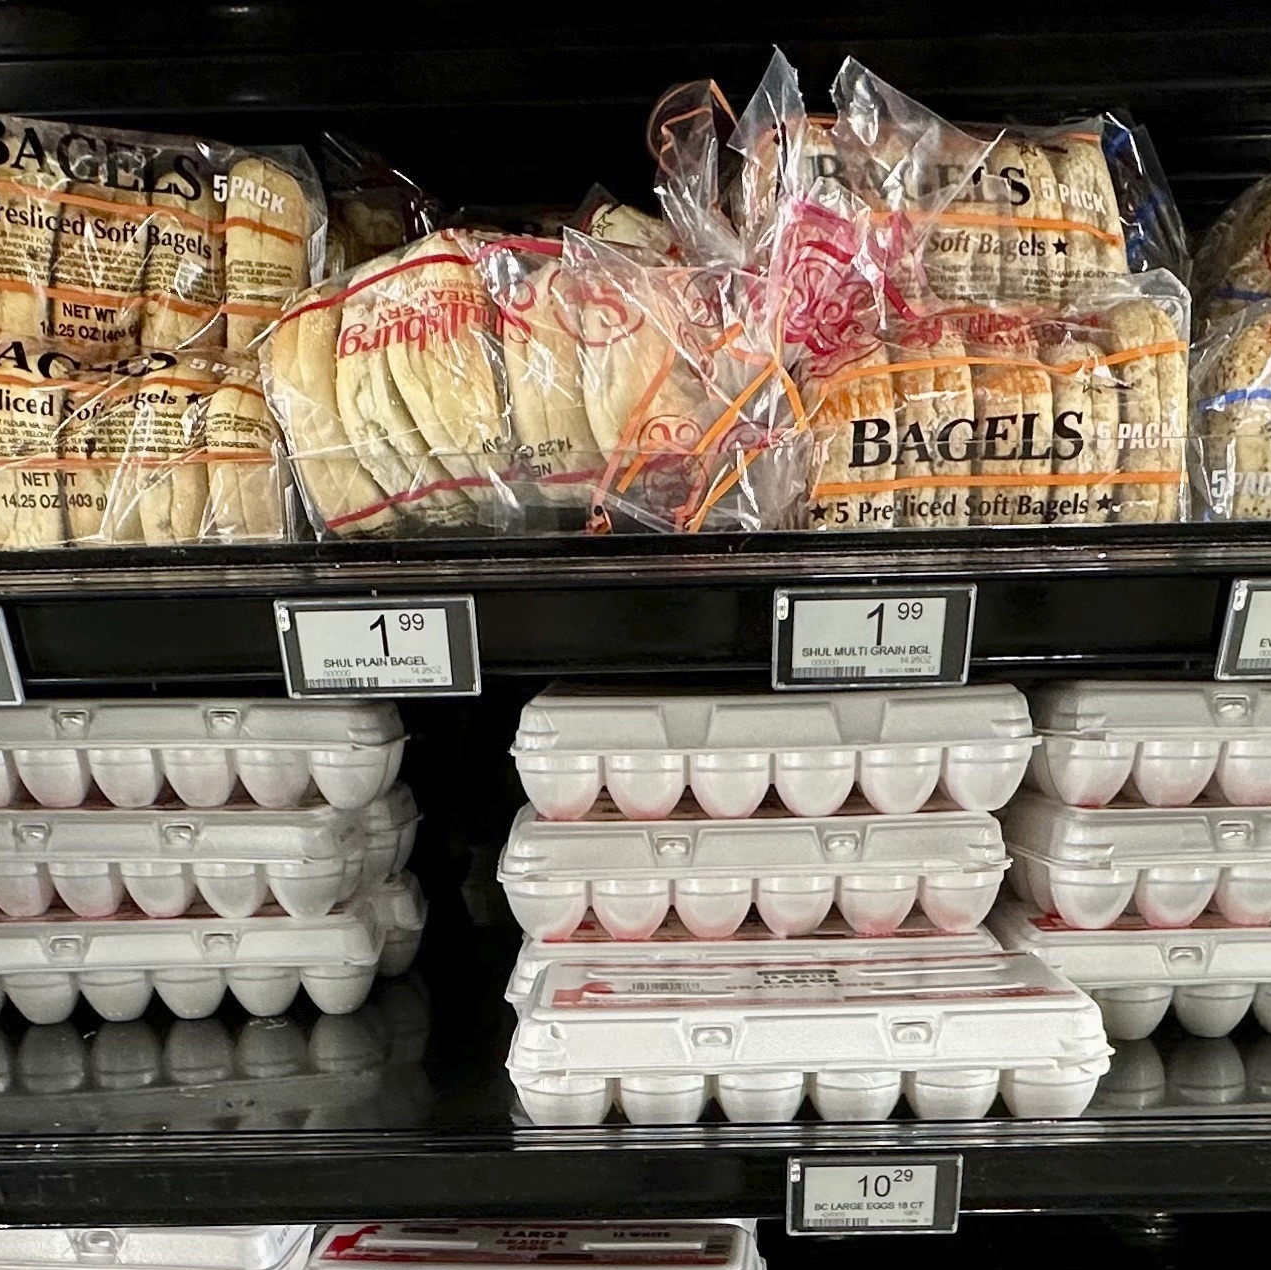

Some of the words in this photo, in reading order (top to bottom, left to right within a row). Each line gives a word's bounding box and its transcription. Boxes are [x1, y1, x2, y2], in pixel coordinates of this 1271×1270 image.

[214, 174, 227, 203] 5
[230, 178, 286, 215] PACK
[1042, 177, 1055, 200] 5
[1060, 183, 1106, 213] PACK
[94, 219, 140, 246] Soft
[146, 223, 212, 260] Bagels
[979, 230, 1046, 260] Bagels
[63, 302, 95, 320] NET
[849, 411, 1084, 468] BAGELS
[1097, 424, 1109, 449] 5
[22, 472, 52, 488] NET
[0, 494, 36, 508] 14.25
[39, 493, 61, 508] OZ
[64, 493, 92, 510] (403
[96, 494, 108, 511] g)
[835, 502, 849, 523] 5
[964, 495, 1007, 519] Soft
[1017, 495, 1088, 522] Bagels
[369, 614, 390, 657] 1
[398, 613, 424, 632] 99
[866, 602, 885, 647] 1
[897, 602, 923, 620] 99
[323, 658, 353, 668] SHUL
[356, 657, 388, 668] PLAIN
[391, 656, 427, 667] BAGEL
[802, 647, 831, 657] SHUL
[834, 646, 868, 657] MULTI
[870, 645, 906, 656] GRAIN
[909, 644, 932, 655] BGL
[857, 1174, 891, 1198] 10
[892, 1168, 914, 1183] 29
[814, 1202, 829, 1211] BC
[830, 1202, 864, 1211] LARGE
[866, 1201, 895, 1210] EGGS
[909, 1201, 925, 1210] CT
